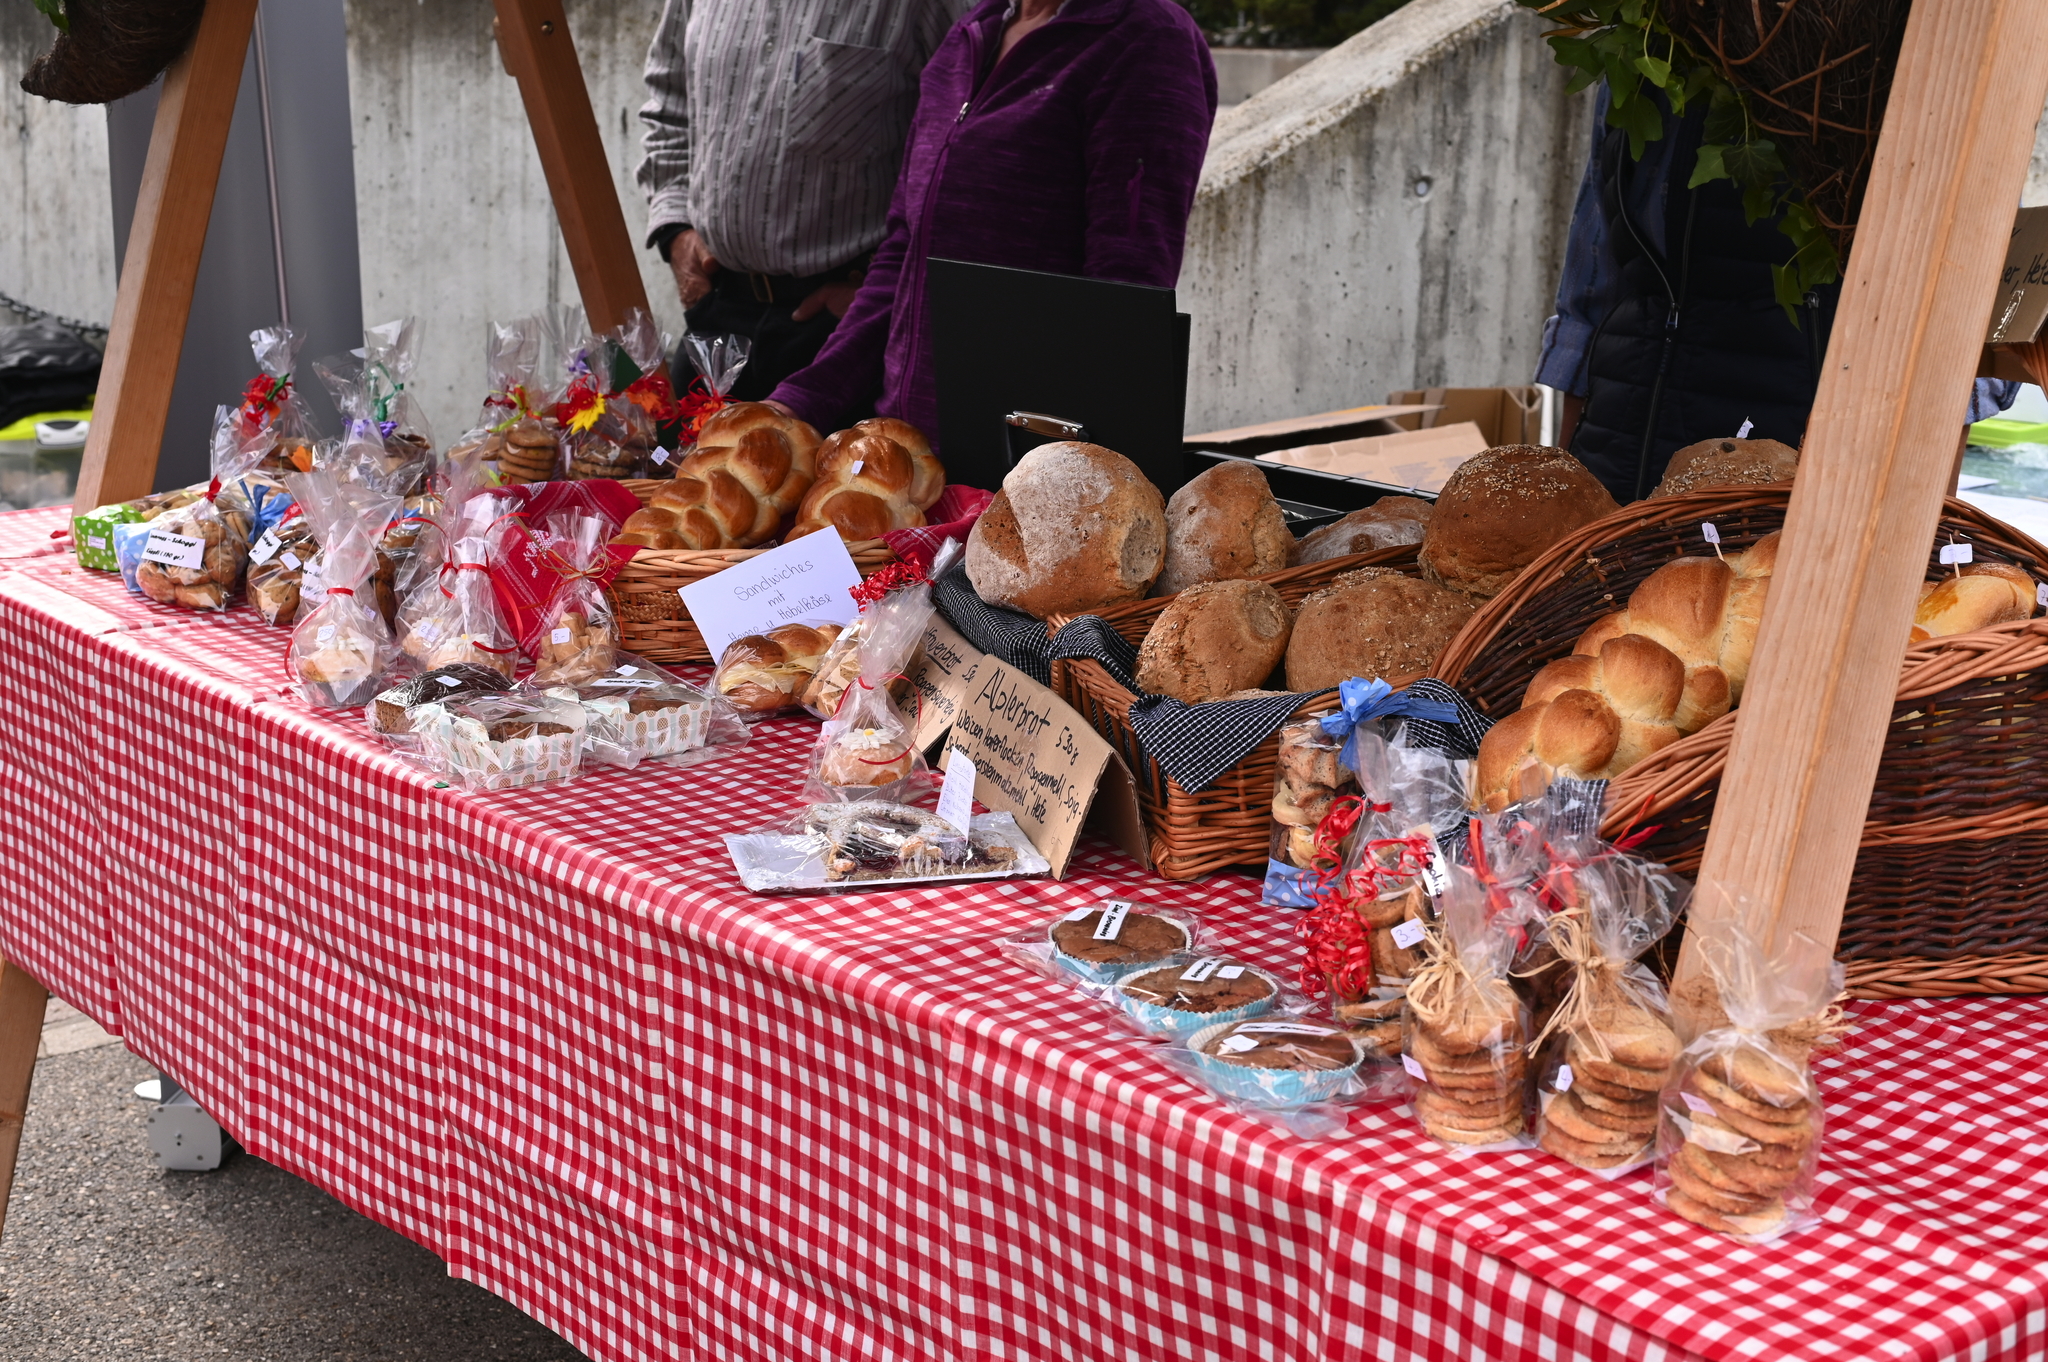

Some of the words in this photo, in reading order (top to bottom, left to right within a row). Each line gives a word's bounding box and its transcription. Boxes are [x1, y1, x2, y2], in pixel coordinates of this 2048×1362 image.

[733, 559, 814, 602] Sandwiches
[767, 588, 787, 607] mit
[776, 592, 833, 621] Hobelkäse
